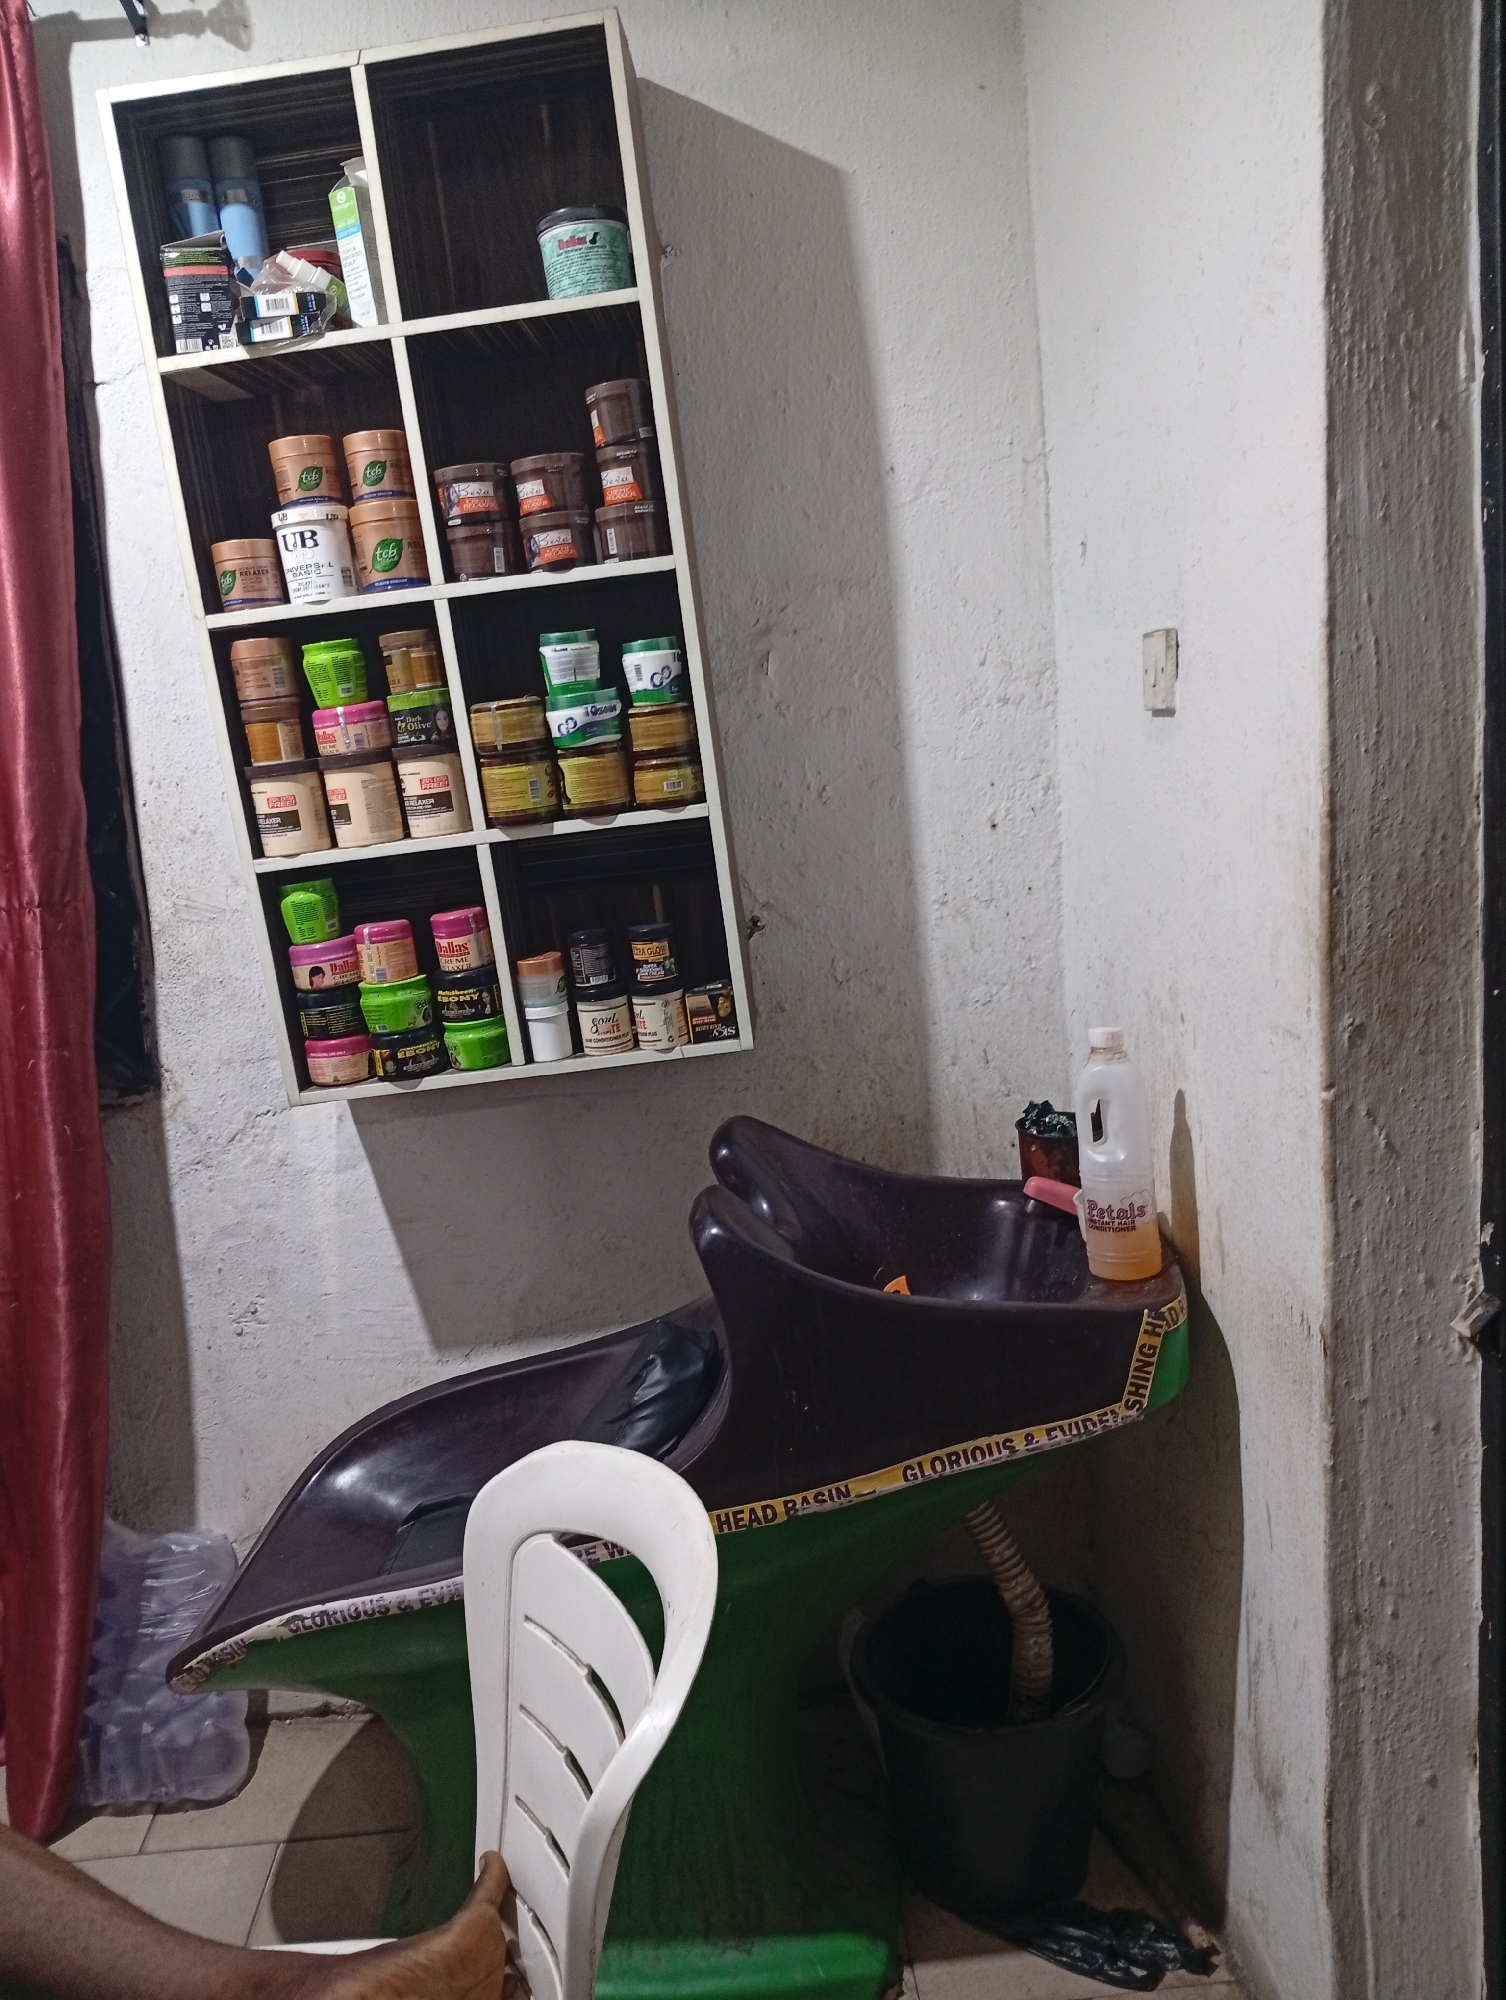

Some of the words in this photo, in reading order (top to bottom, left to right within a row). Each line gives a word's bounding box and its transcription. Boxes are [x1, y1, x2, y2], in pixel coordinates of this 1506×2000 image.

[301, 470, 318, 483] tcb
[365, 464, 383, 478] tcb
[281, 529, 320, 552] UB
[375, 542, 397, 562] tcb
[239, 569, 270, 577] RELAXER
[406, 715, 422, 723] Dark
[407, 721, 433, 731] Olive
[421, 780, 449, 790] FREE!
[269, 800, 297, 809] FREE!
[437, 993, 480, 1003] EBONY
[397, 1041, 441, 1059] EBONY
[1087, 1199, 1147, 1220] Petals
[1088, 1223, 1137, 1233] CONDITIONER
[902, 1437, 1020, 1484] GLORIOUS
[717, 1502, 778, 1534] HEAD
[783, 1484, 852, 1519] BASIN
[287, 1596, 392, 1635] GLORIOUS
